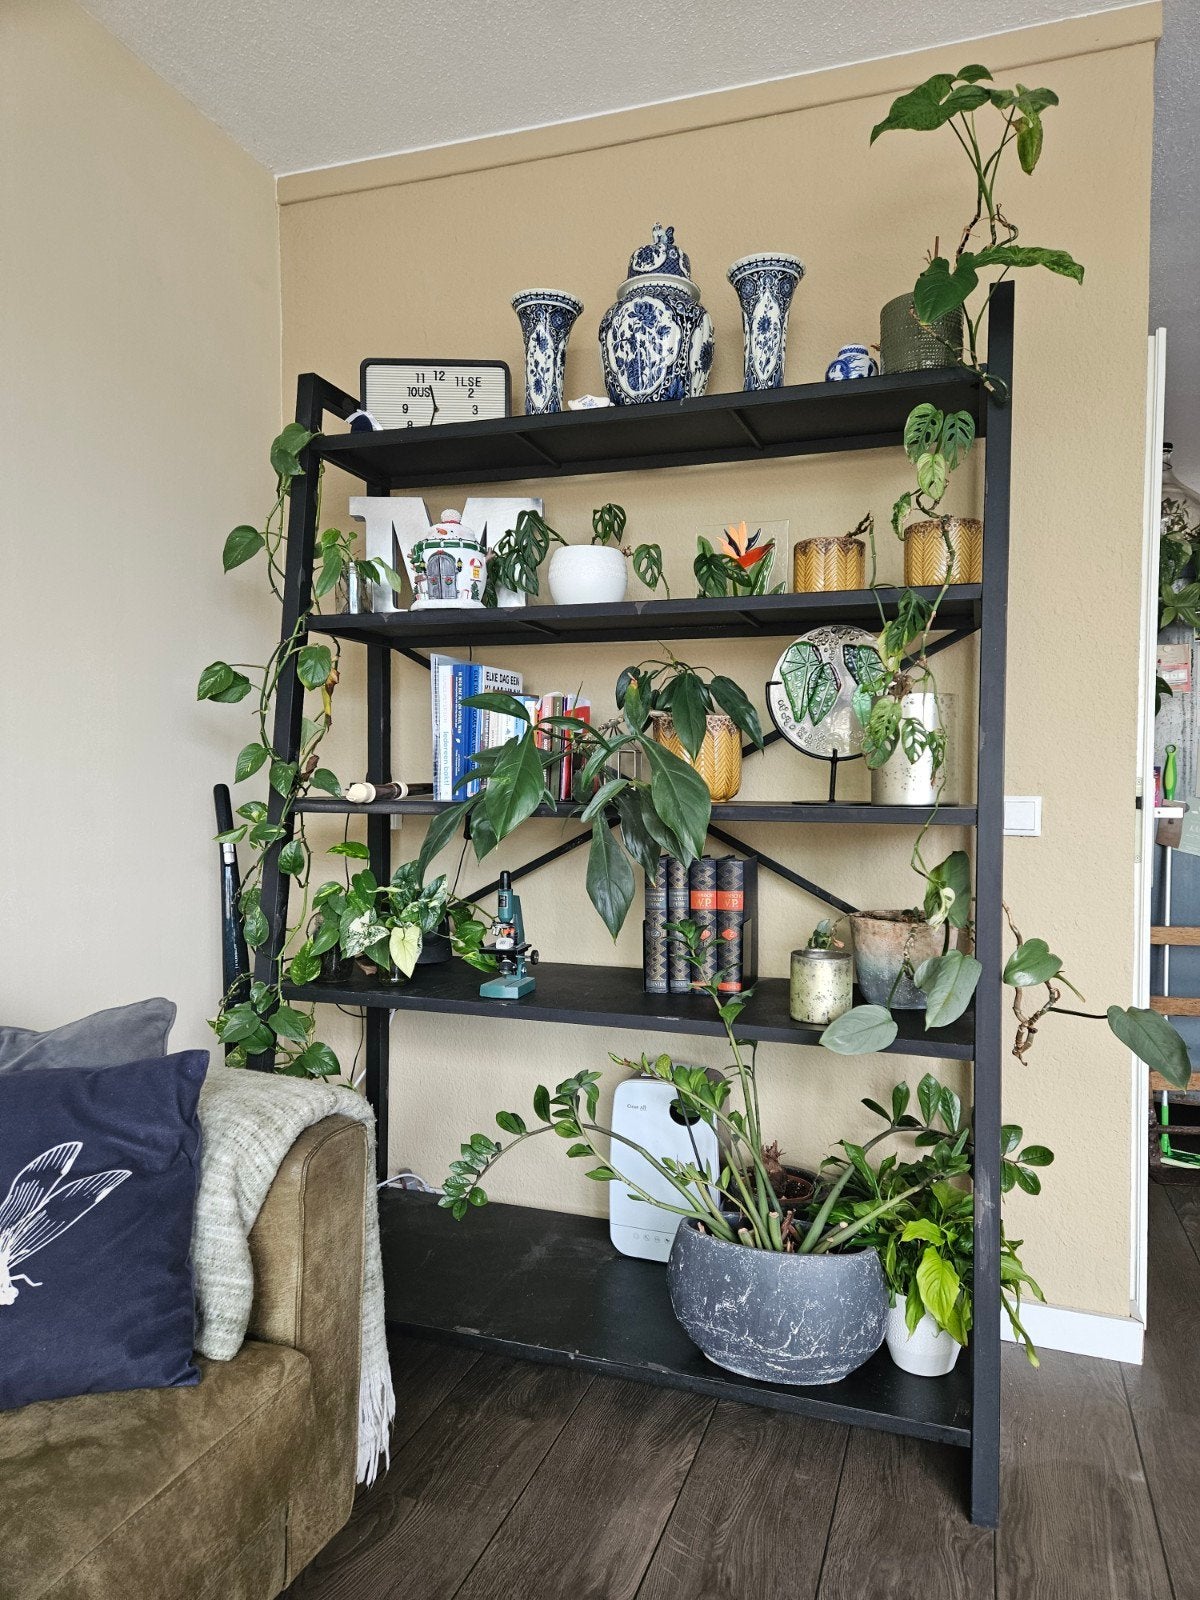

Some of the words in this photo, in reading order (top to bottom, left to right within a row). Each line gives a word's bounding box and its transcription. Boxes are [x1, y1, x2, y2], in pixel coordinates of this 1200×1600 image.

[416, 373, 425, 383] 11
[433, 371, 445, 381] 12
[468, 389, 474, 398] 2
[402, 404, 409, 414] 9
[472, 405, 478, 415] 3
[486, 671, 498, 683] ELKE
[499, 673, 509, 685] DAG
[510, 676, 520, 686] EEN
